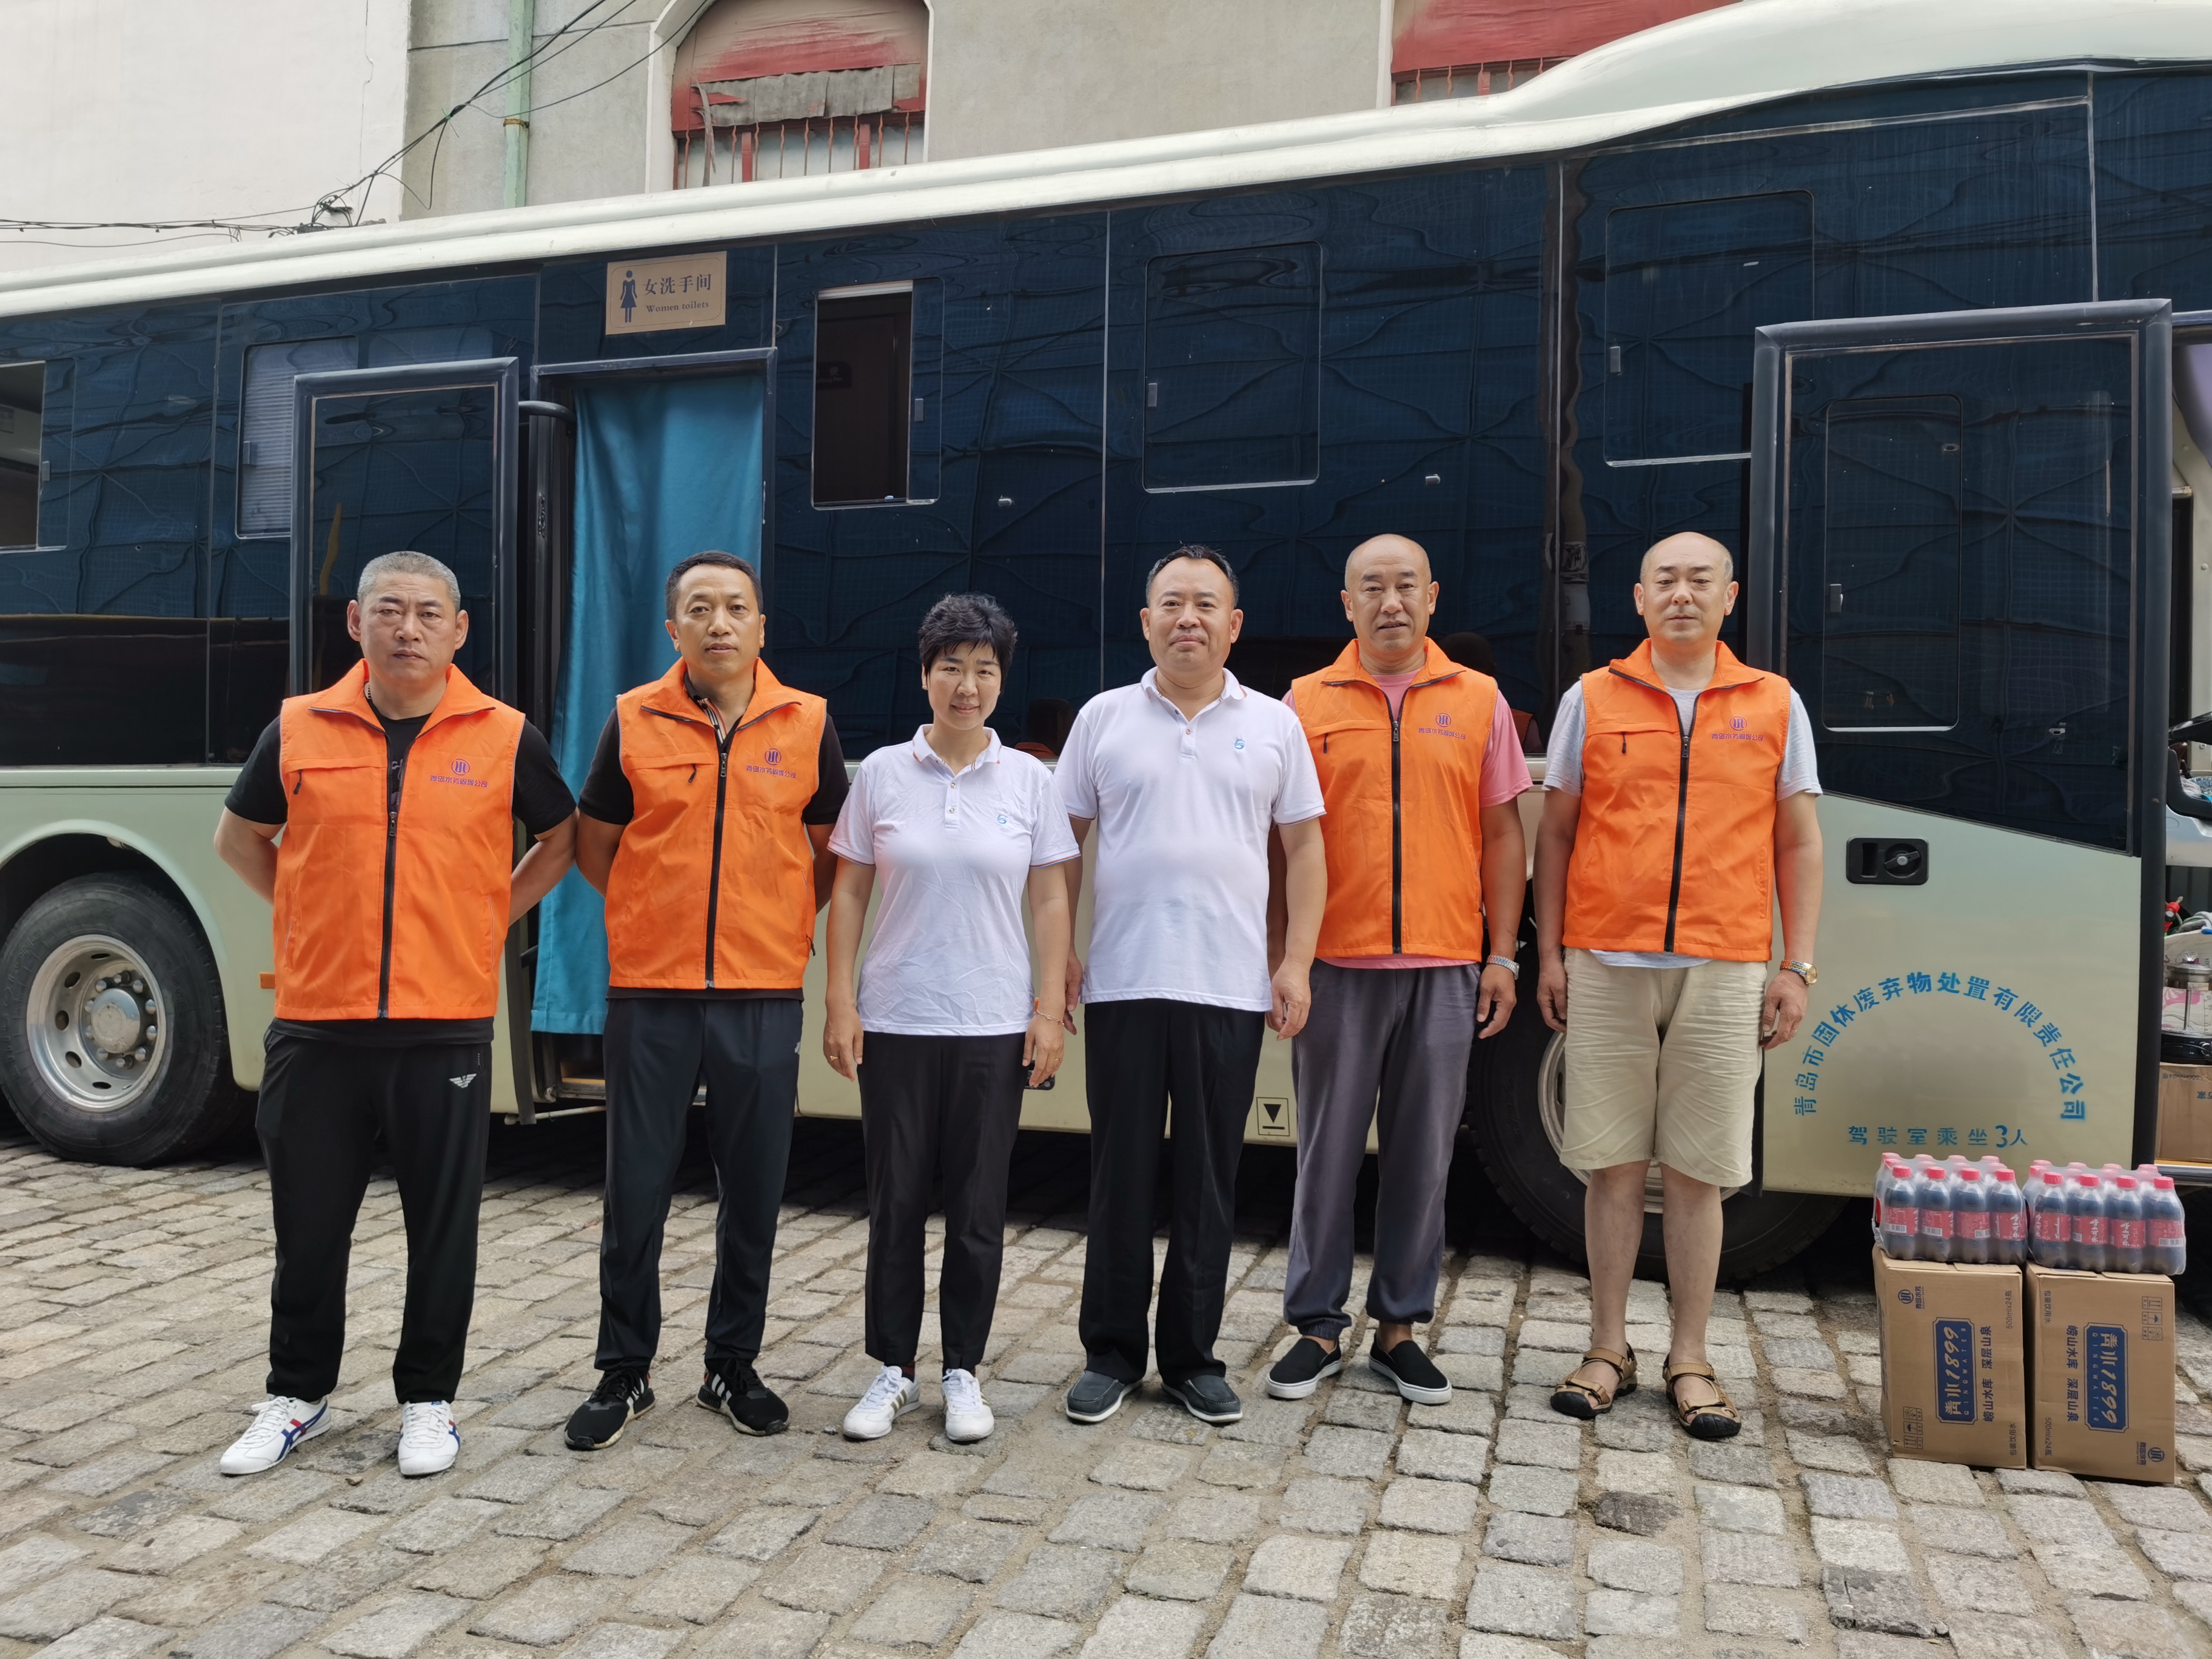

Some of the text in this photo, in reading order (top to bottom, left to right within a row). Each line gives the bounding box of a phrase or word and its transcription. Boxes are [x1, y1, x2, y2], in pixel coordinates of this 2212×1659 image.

[643, 273, 711, 295] 女洗手间
[646, 301, 709, 313] Women toilets
[1712, 732, 1764, 742] 青岛水务固废公司
[430, 775, 488, 788] 青岛水务固废公司
[1794, 971, 2087, 1121] 青岛市固体废弃物处置有限责任公司
[1848, 1124, 2028, 1148] 驾驶室乘坐3人
[1980, 1326, 1994, 1422] 崂山水库 深层山泉
[2066, 1325, 2079, 1422] 崂山水库 深层山泉
[2008, 1423, 2017, 1456] 包装饮用水
